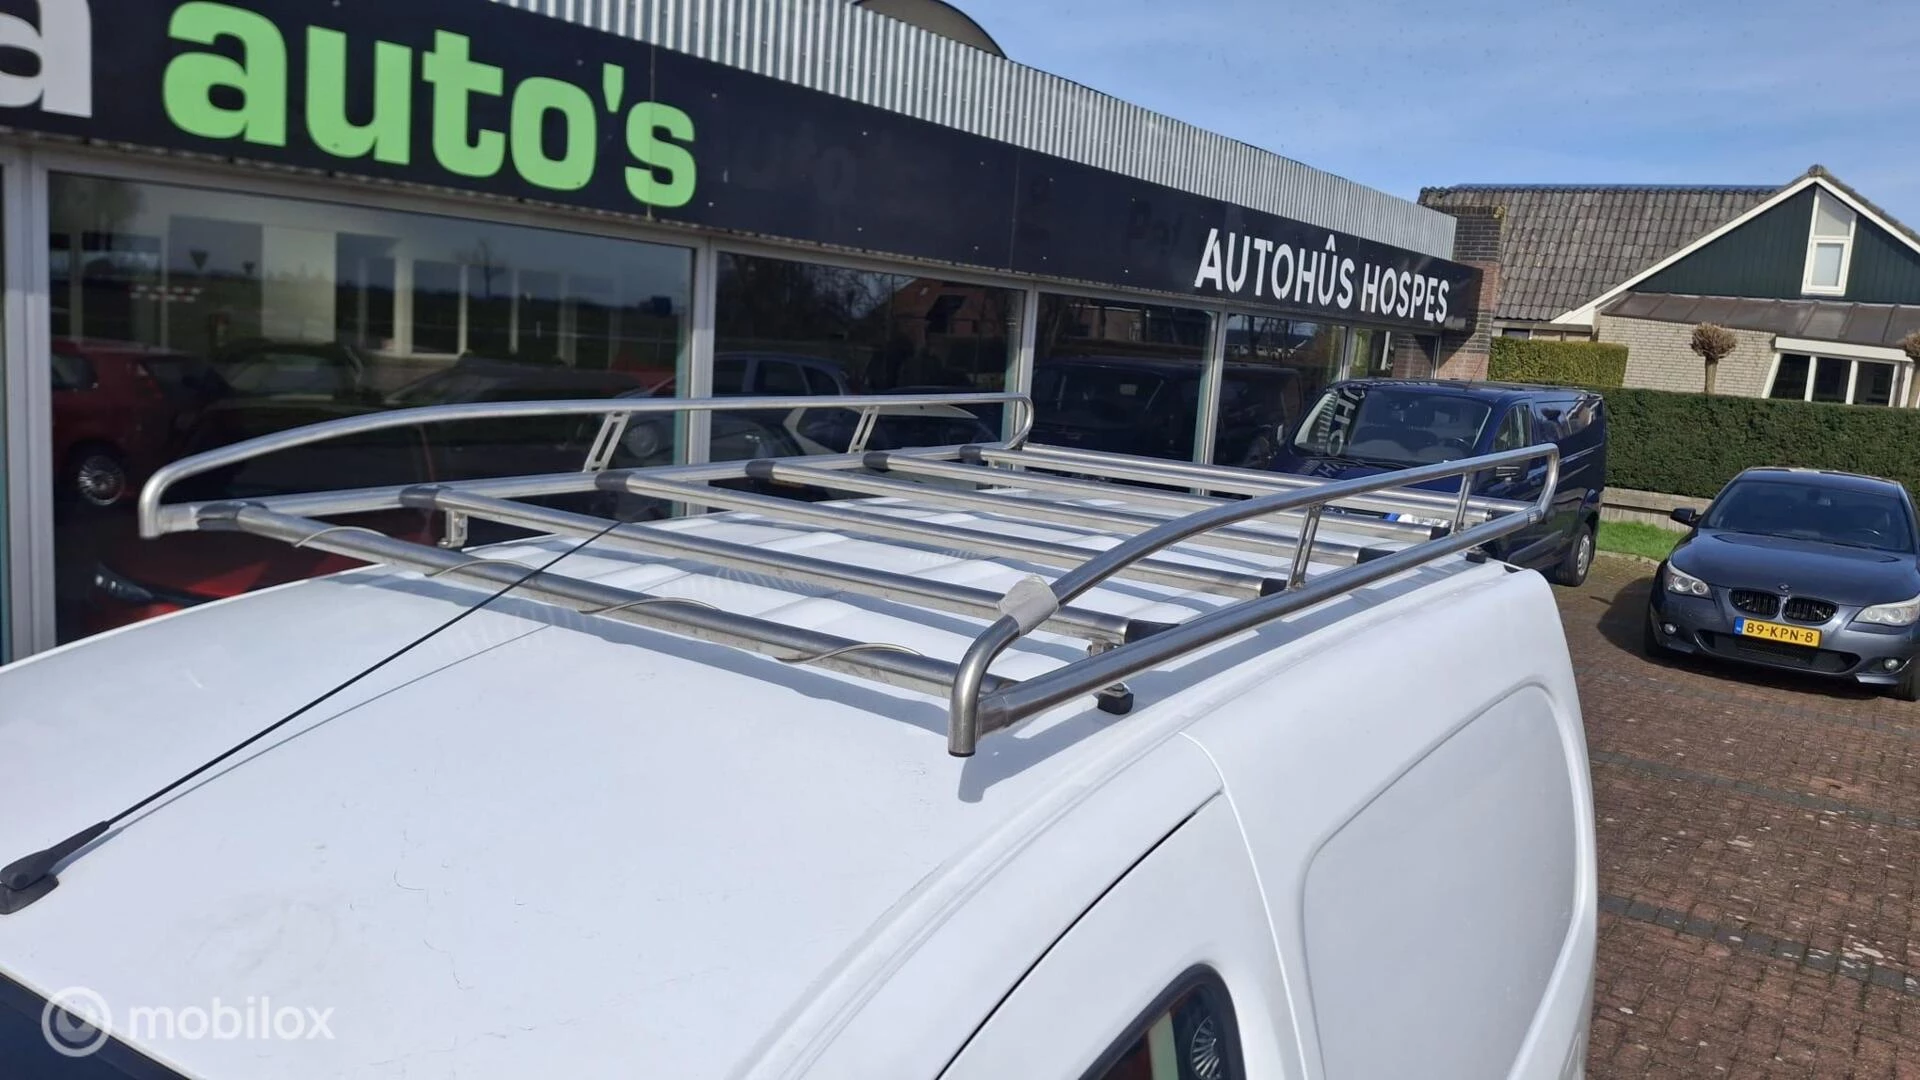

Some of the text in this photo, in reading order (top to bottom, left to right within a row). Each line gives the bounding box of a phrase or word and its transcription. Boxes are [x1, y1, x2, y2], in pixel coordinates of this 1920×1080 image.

[162, 0, 697, 208] auto's
[1194, 228, 1449, 324] AUTOHÛS HOSPES
[1746, 622, 1814, 643] 89-KPN-8
